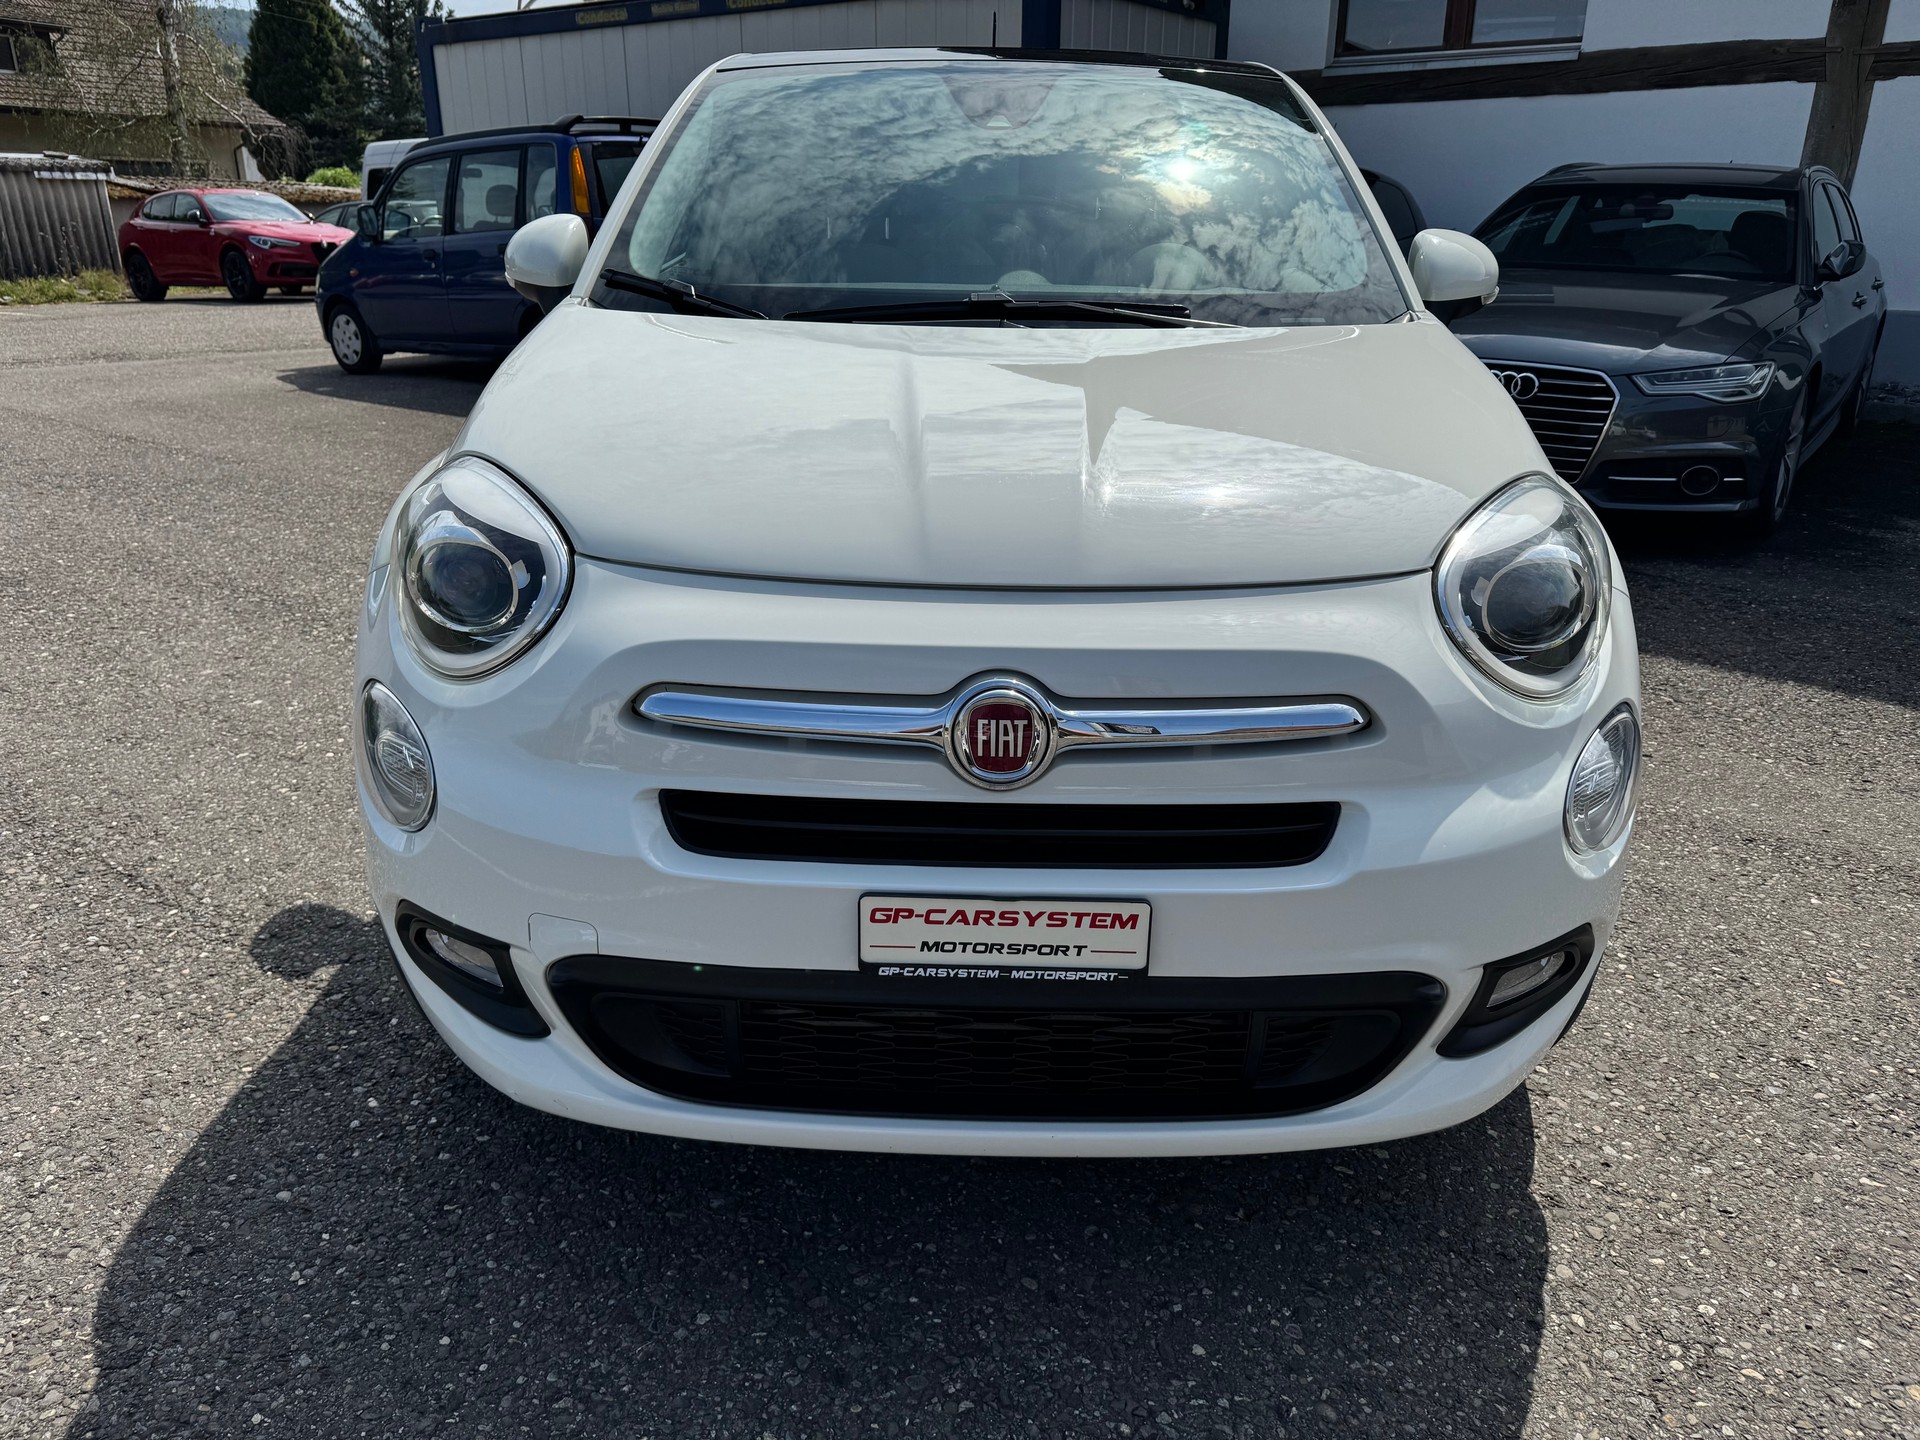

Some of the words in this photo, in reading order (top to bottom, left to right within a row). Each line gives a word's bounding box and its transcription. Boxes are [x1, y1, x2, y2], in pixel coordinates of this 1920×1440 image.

[977, 719, 1028, 758] FIAT
[869, 907, 1140, 930] GP-CARSYSTEM
[919, 940, 1088, 957] MOTORSPORT
